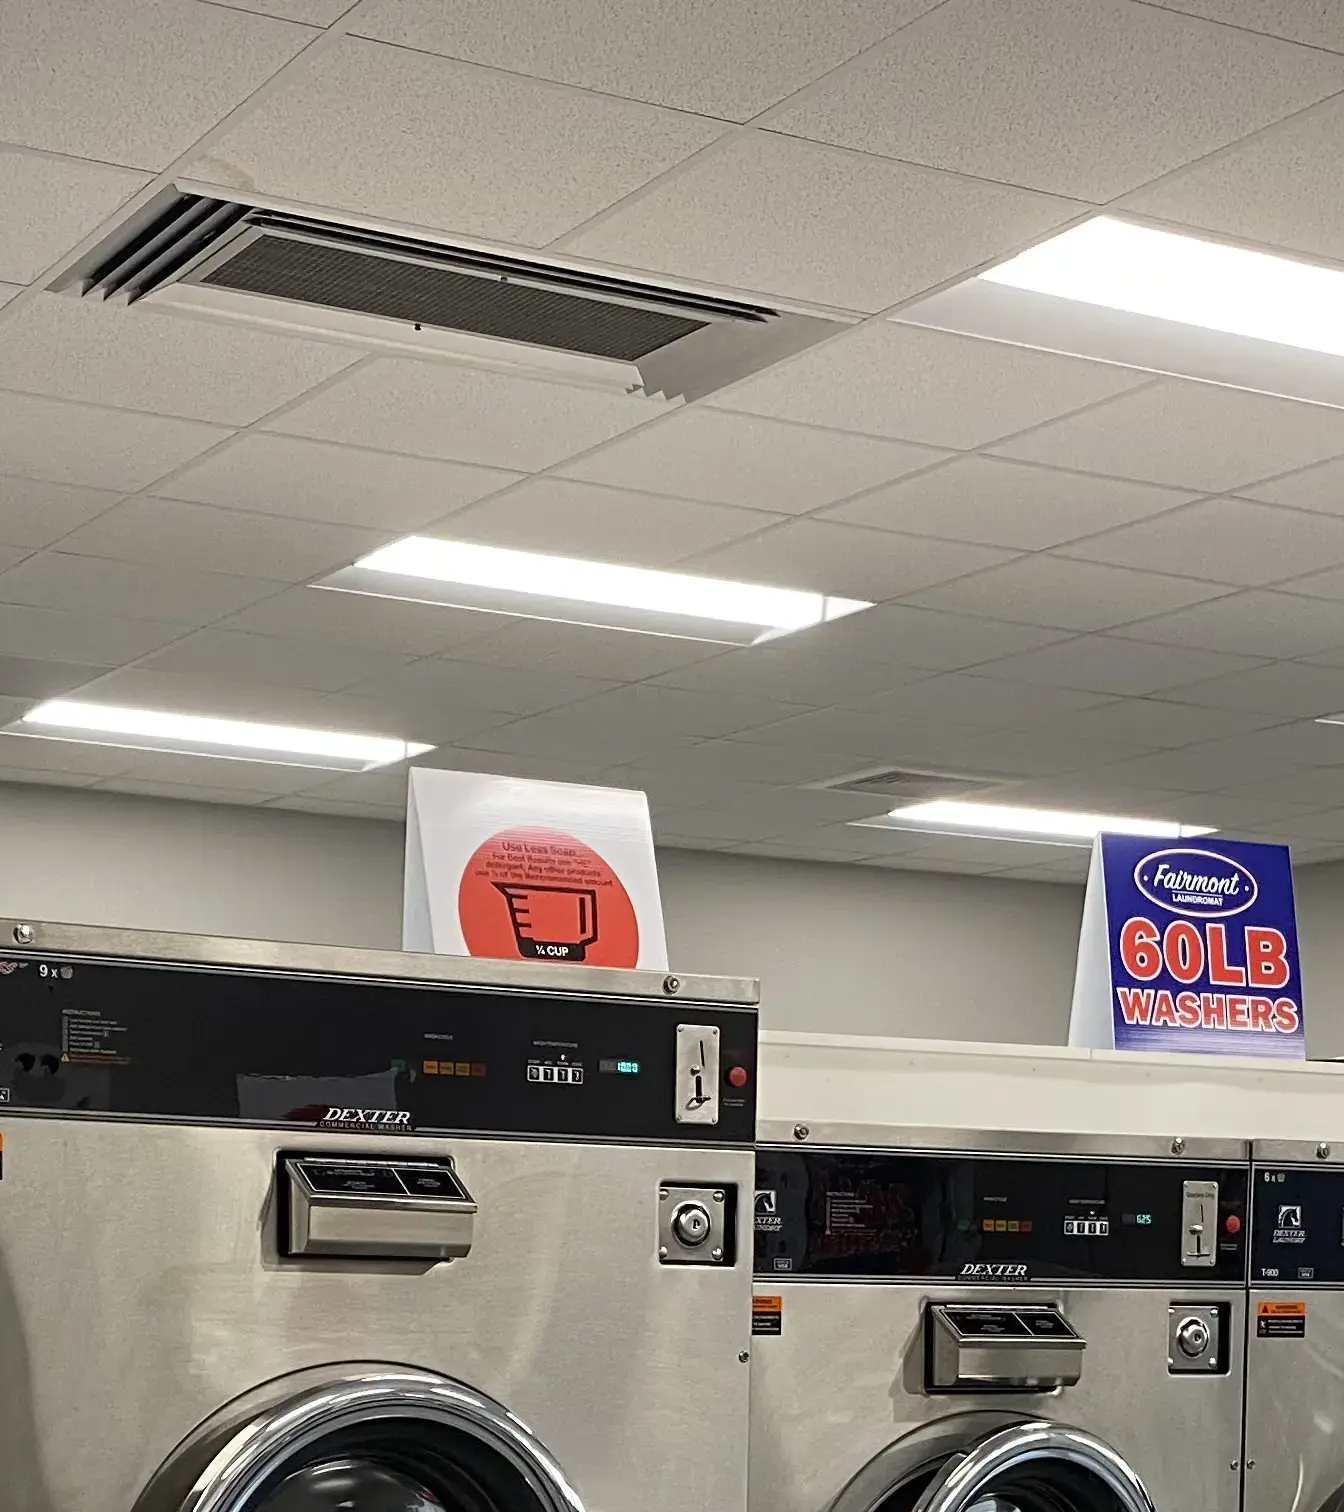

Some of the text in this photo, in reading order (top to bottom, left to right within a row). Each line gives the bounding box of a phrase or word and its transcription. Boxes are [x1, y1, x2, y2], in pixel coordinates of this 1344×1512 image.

[501, 841, 523, 852] Use
[523, 843, 549, 855] Less
[1153, 864, 1240, 895] Fairmont
[1172, 893, 1224, 907] LAUNDROMAT
[546, 945, 569, 957] CUP
[1119, 916, 1290, 989] 60LB
[39, 964, 48, 977] 9
[1116, 986, 1299, 1033] WASHERS
[323, 1107, 411, 1124] DEXTER
[319, 1120, 375, 1130] COMMERCIAL
[960, 1263, 1028, 1276] DEXTER
